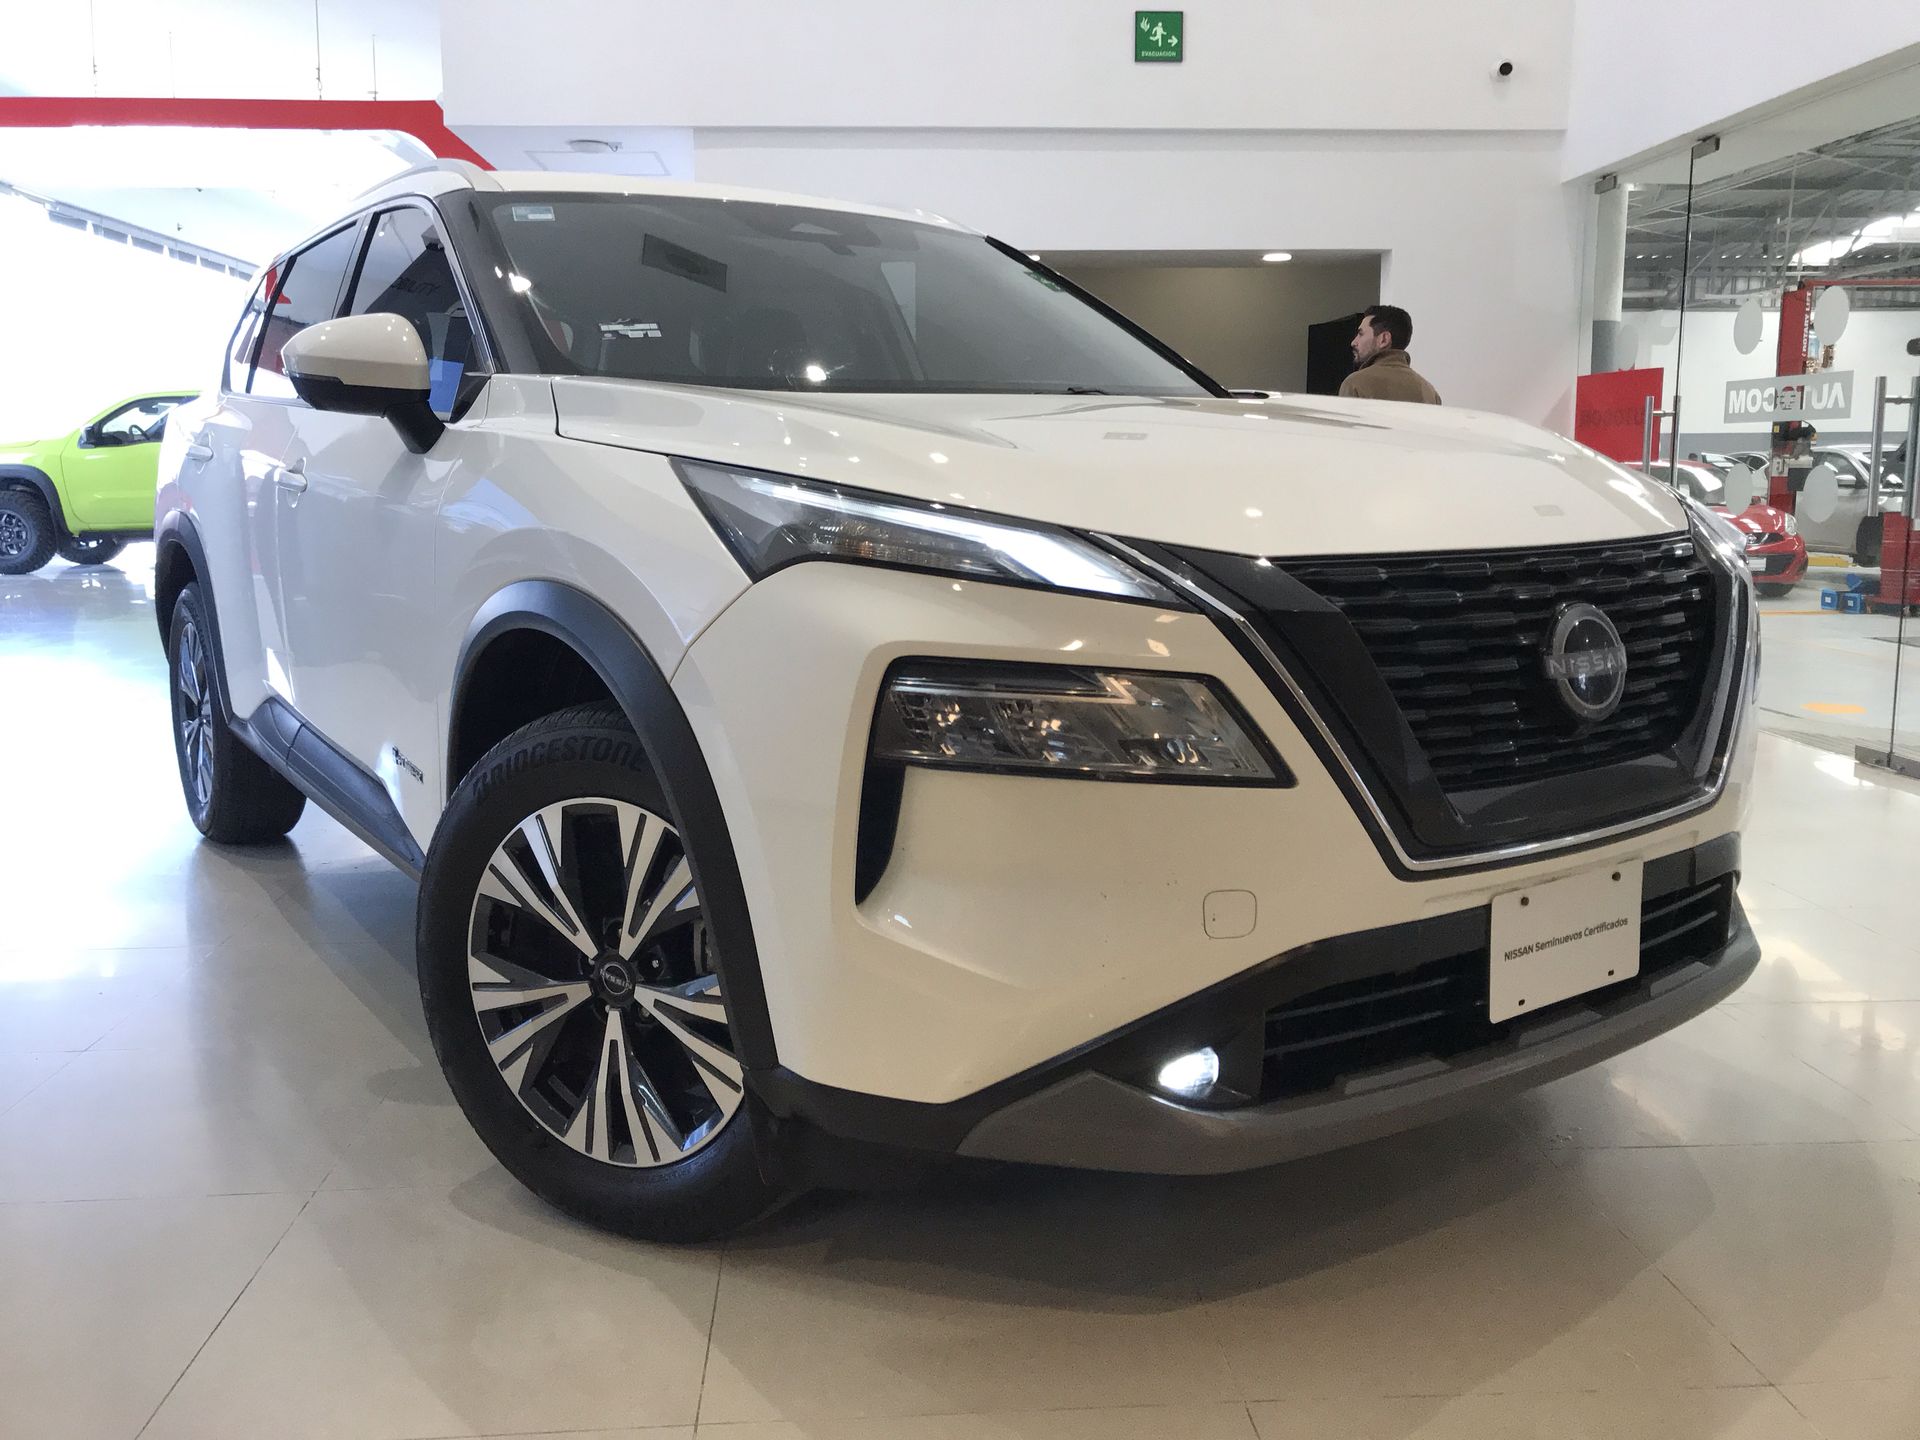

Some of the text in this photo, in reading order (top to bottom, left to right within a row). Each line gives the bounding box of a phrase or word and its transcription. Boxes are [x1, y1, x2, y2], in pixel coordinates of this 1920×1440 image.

[1548, 650, 1627, 677] NISSAN
[472, 735, 650, 799] BRIDGESTONE
[1503, 916, 1629, 962] NISSAN Seminuevos Certificados
